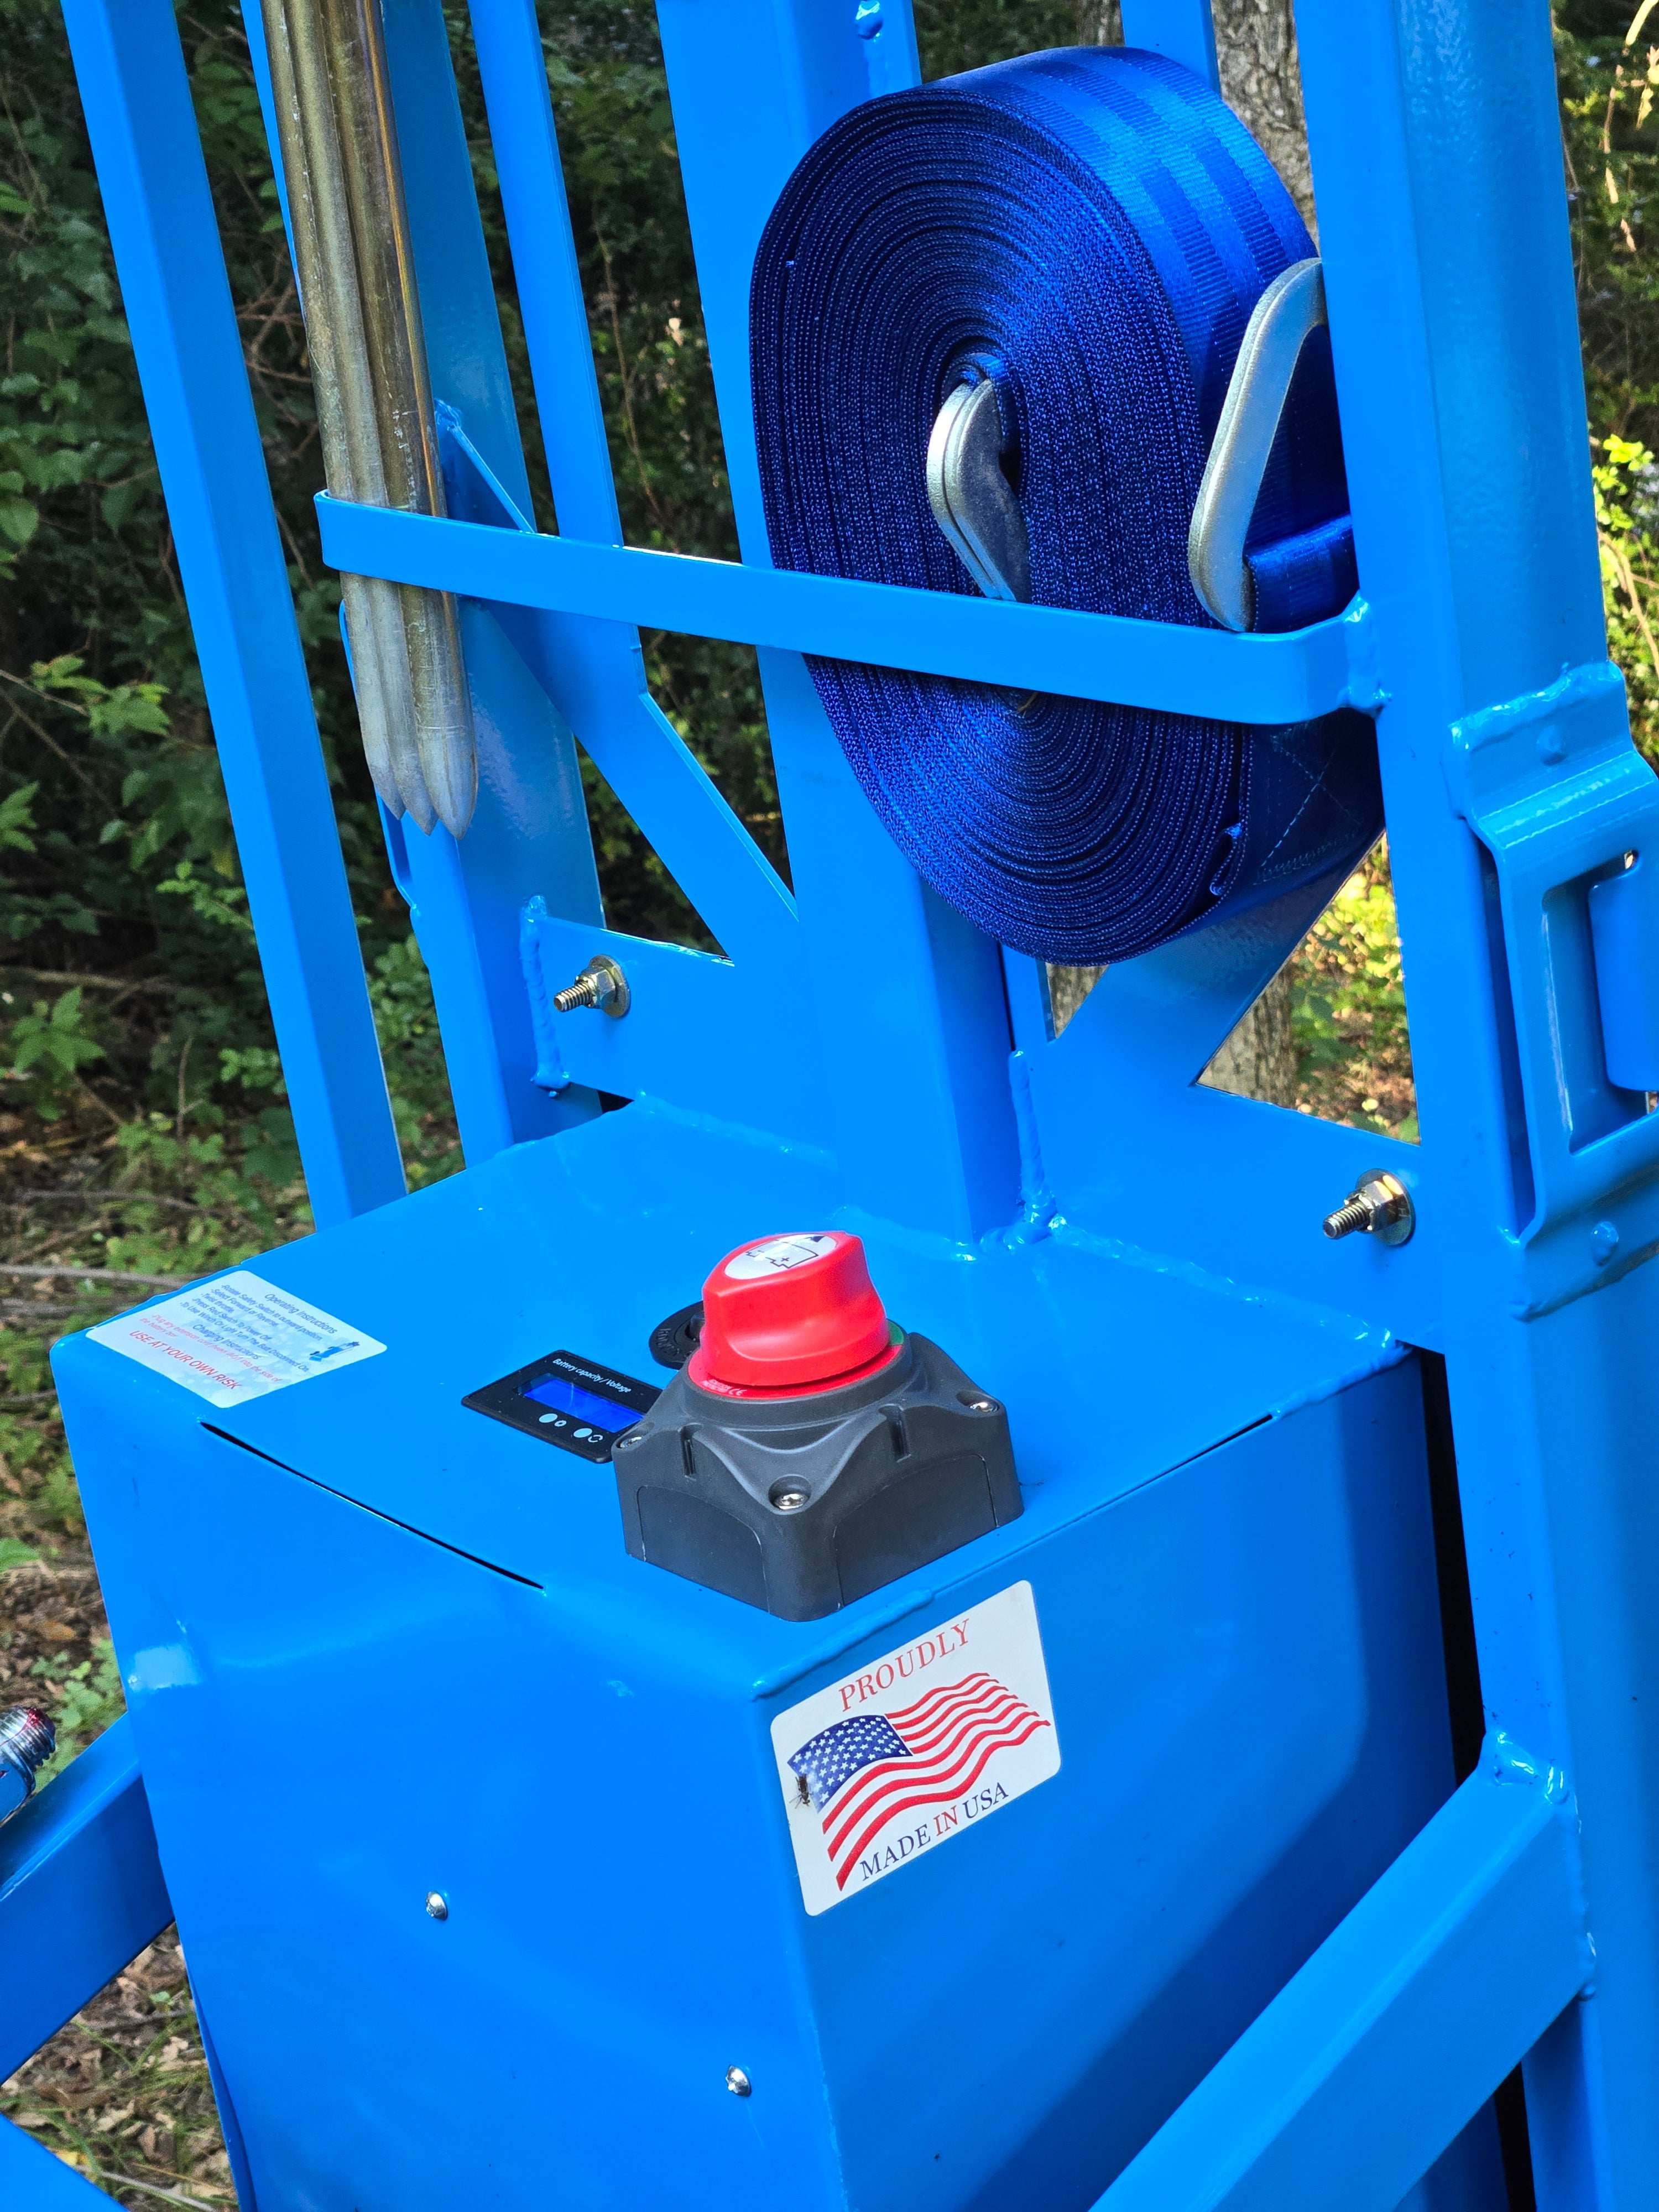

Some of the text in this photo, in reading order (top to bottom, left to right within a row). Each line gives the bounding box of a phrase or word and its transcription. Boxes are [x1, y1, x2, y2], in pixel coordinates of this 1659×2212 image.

[207, 1307, 222, 1315] Red
[218, 1313, 238, 1324] Switch
[243, 1326, 262, 1336] Power
[228, 1298, 253, 1312] Forward
[239, 1294, 258, 1305] Safety
[255, 1303, 275, 1314] Switch
[278, 1317, 304, 1329] outward
[264, 1294, 337, 1334] Operating Instructions
[173, 1327, 200, 1339] extension
[192, 1324, 263, 1359] Charging Instructions
[198, 1312, 216, 1323] Winch
[221, 1325, 237, 1333] Light
[235, 1331, 249, 1339] Turn
[268, 1349, 301, 1366] Disconnect
[129, 1331, 155, 1342] USE
[162, 1347, 194, 1363] YOUR
[189, 1361, 218, 1375] OWN
[212, 1374, 242, 1390] RISK
[552, 1359, 578, 1371] Battery
[576, 1369, 604, 1382] capacity
[606, 1379, 632, 1393] Voltage
[838, 1619, 970, 1712] PROUDLY
[859, 1782, 1009, 1881] MADE IN USA
